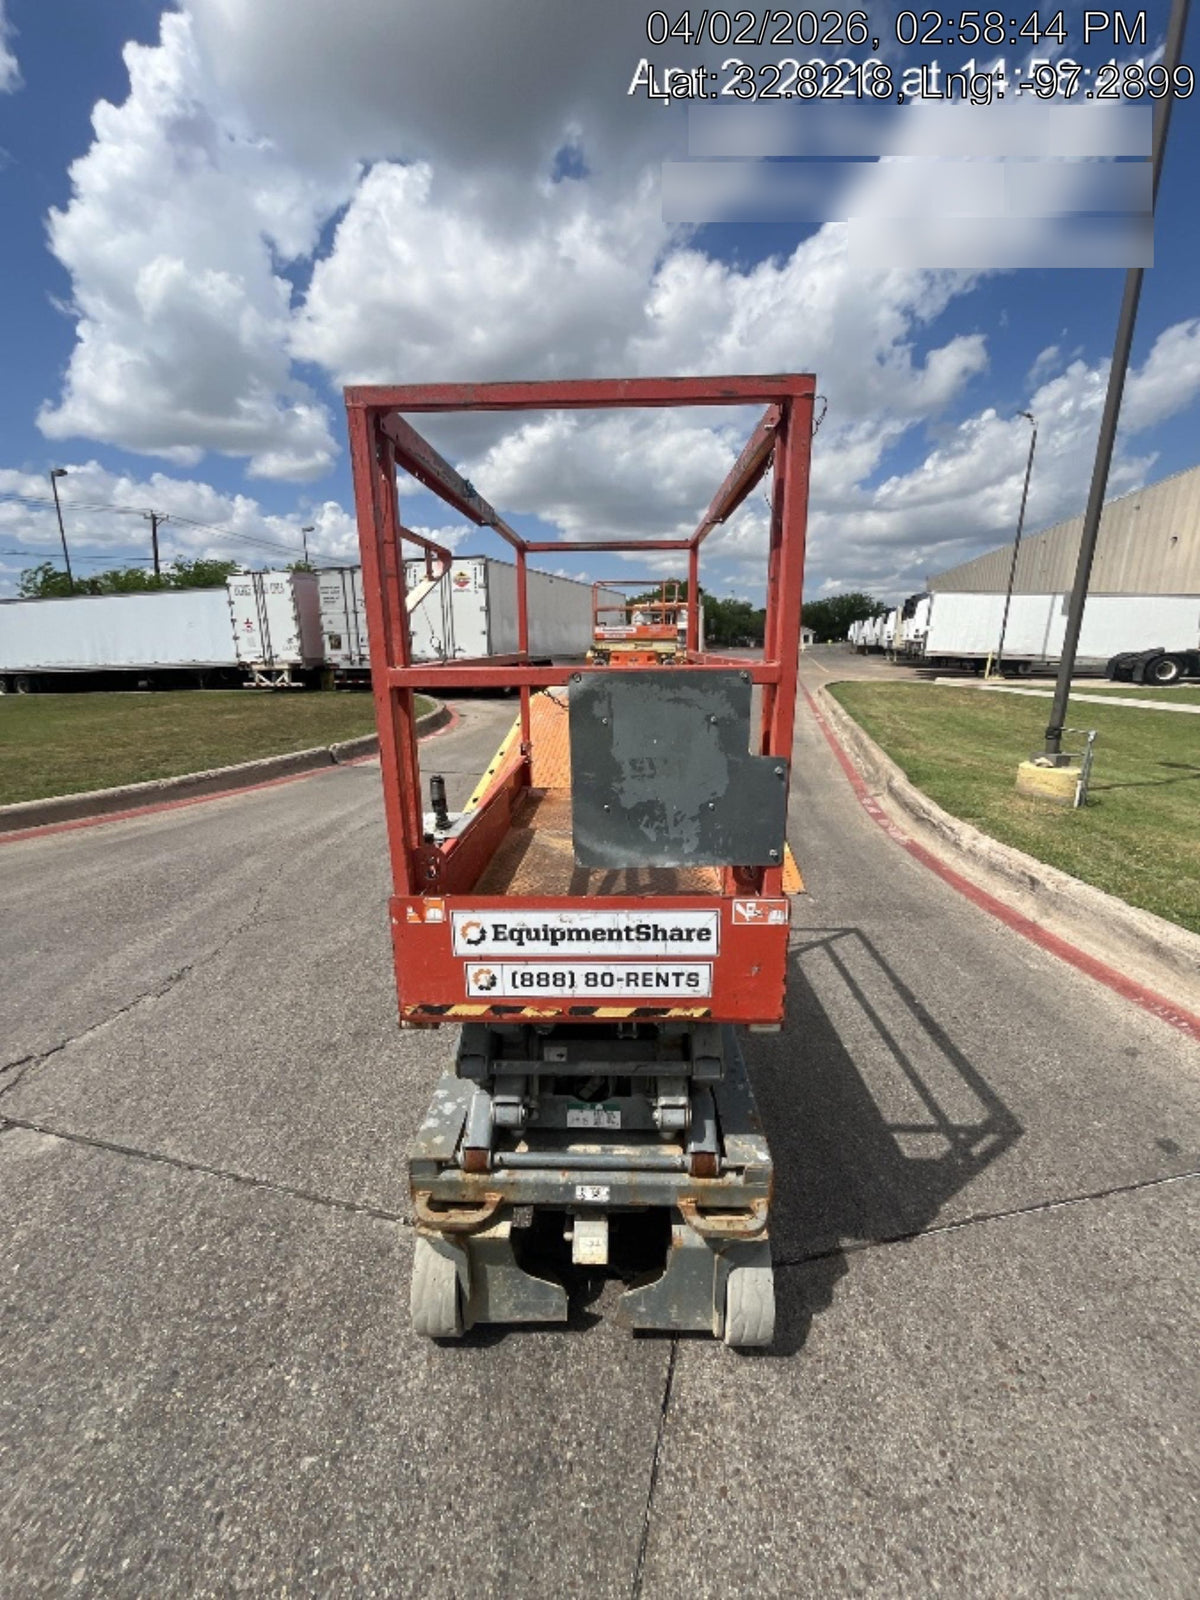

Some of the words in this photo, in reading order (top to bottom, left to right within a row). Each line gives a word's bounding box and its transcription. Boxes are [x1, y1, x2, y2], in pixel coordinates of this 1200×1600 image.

[492, 924, 711, 946] EquipmentShare
[511, 970, 575, 988] (888)
[585, 971, 699, 988] 80-RENTS
